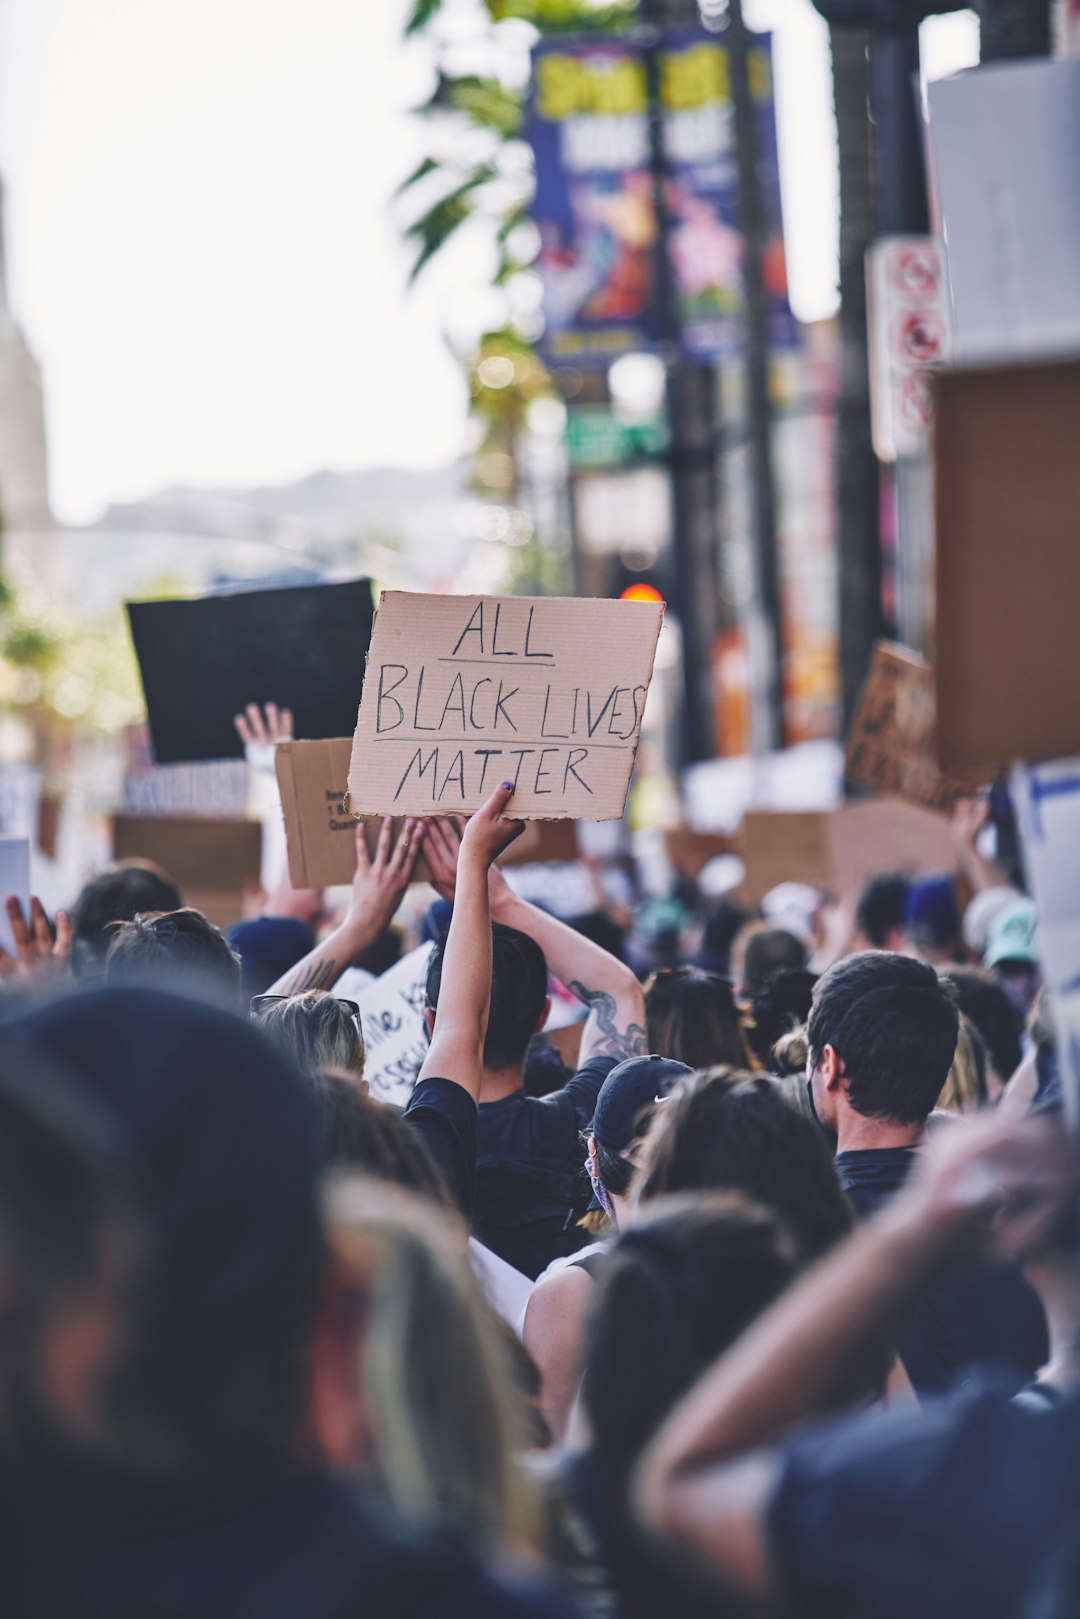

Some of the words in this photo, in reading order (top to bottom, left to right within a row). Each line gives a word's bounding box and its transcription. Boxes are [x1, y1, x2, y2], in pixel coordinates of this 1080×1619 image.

[452, 600, 553, 658] ALL
[376, 664, 520, 734] BLACK
[541, 684, 648, 740] LIVES
[393, 747, 594, 802] MATTER
